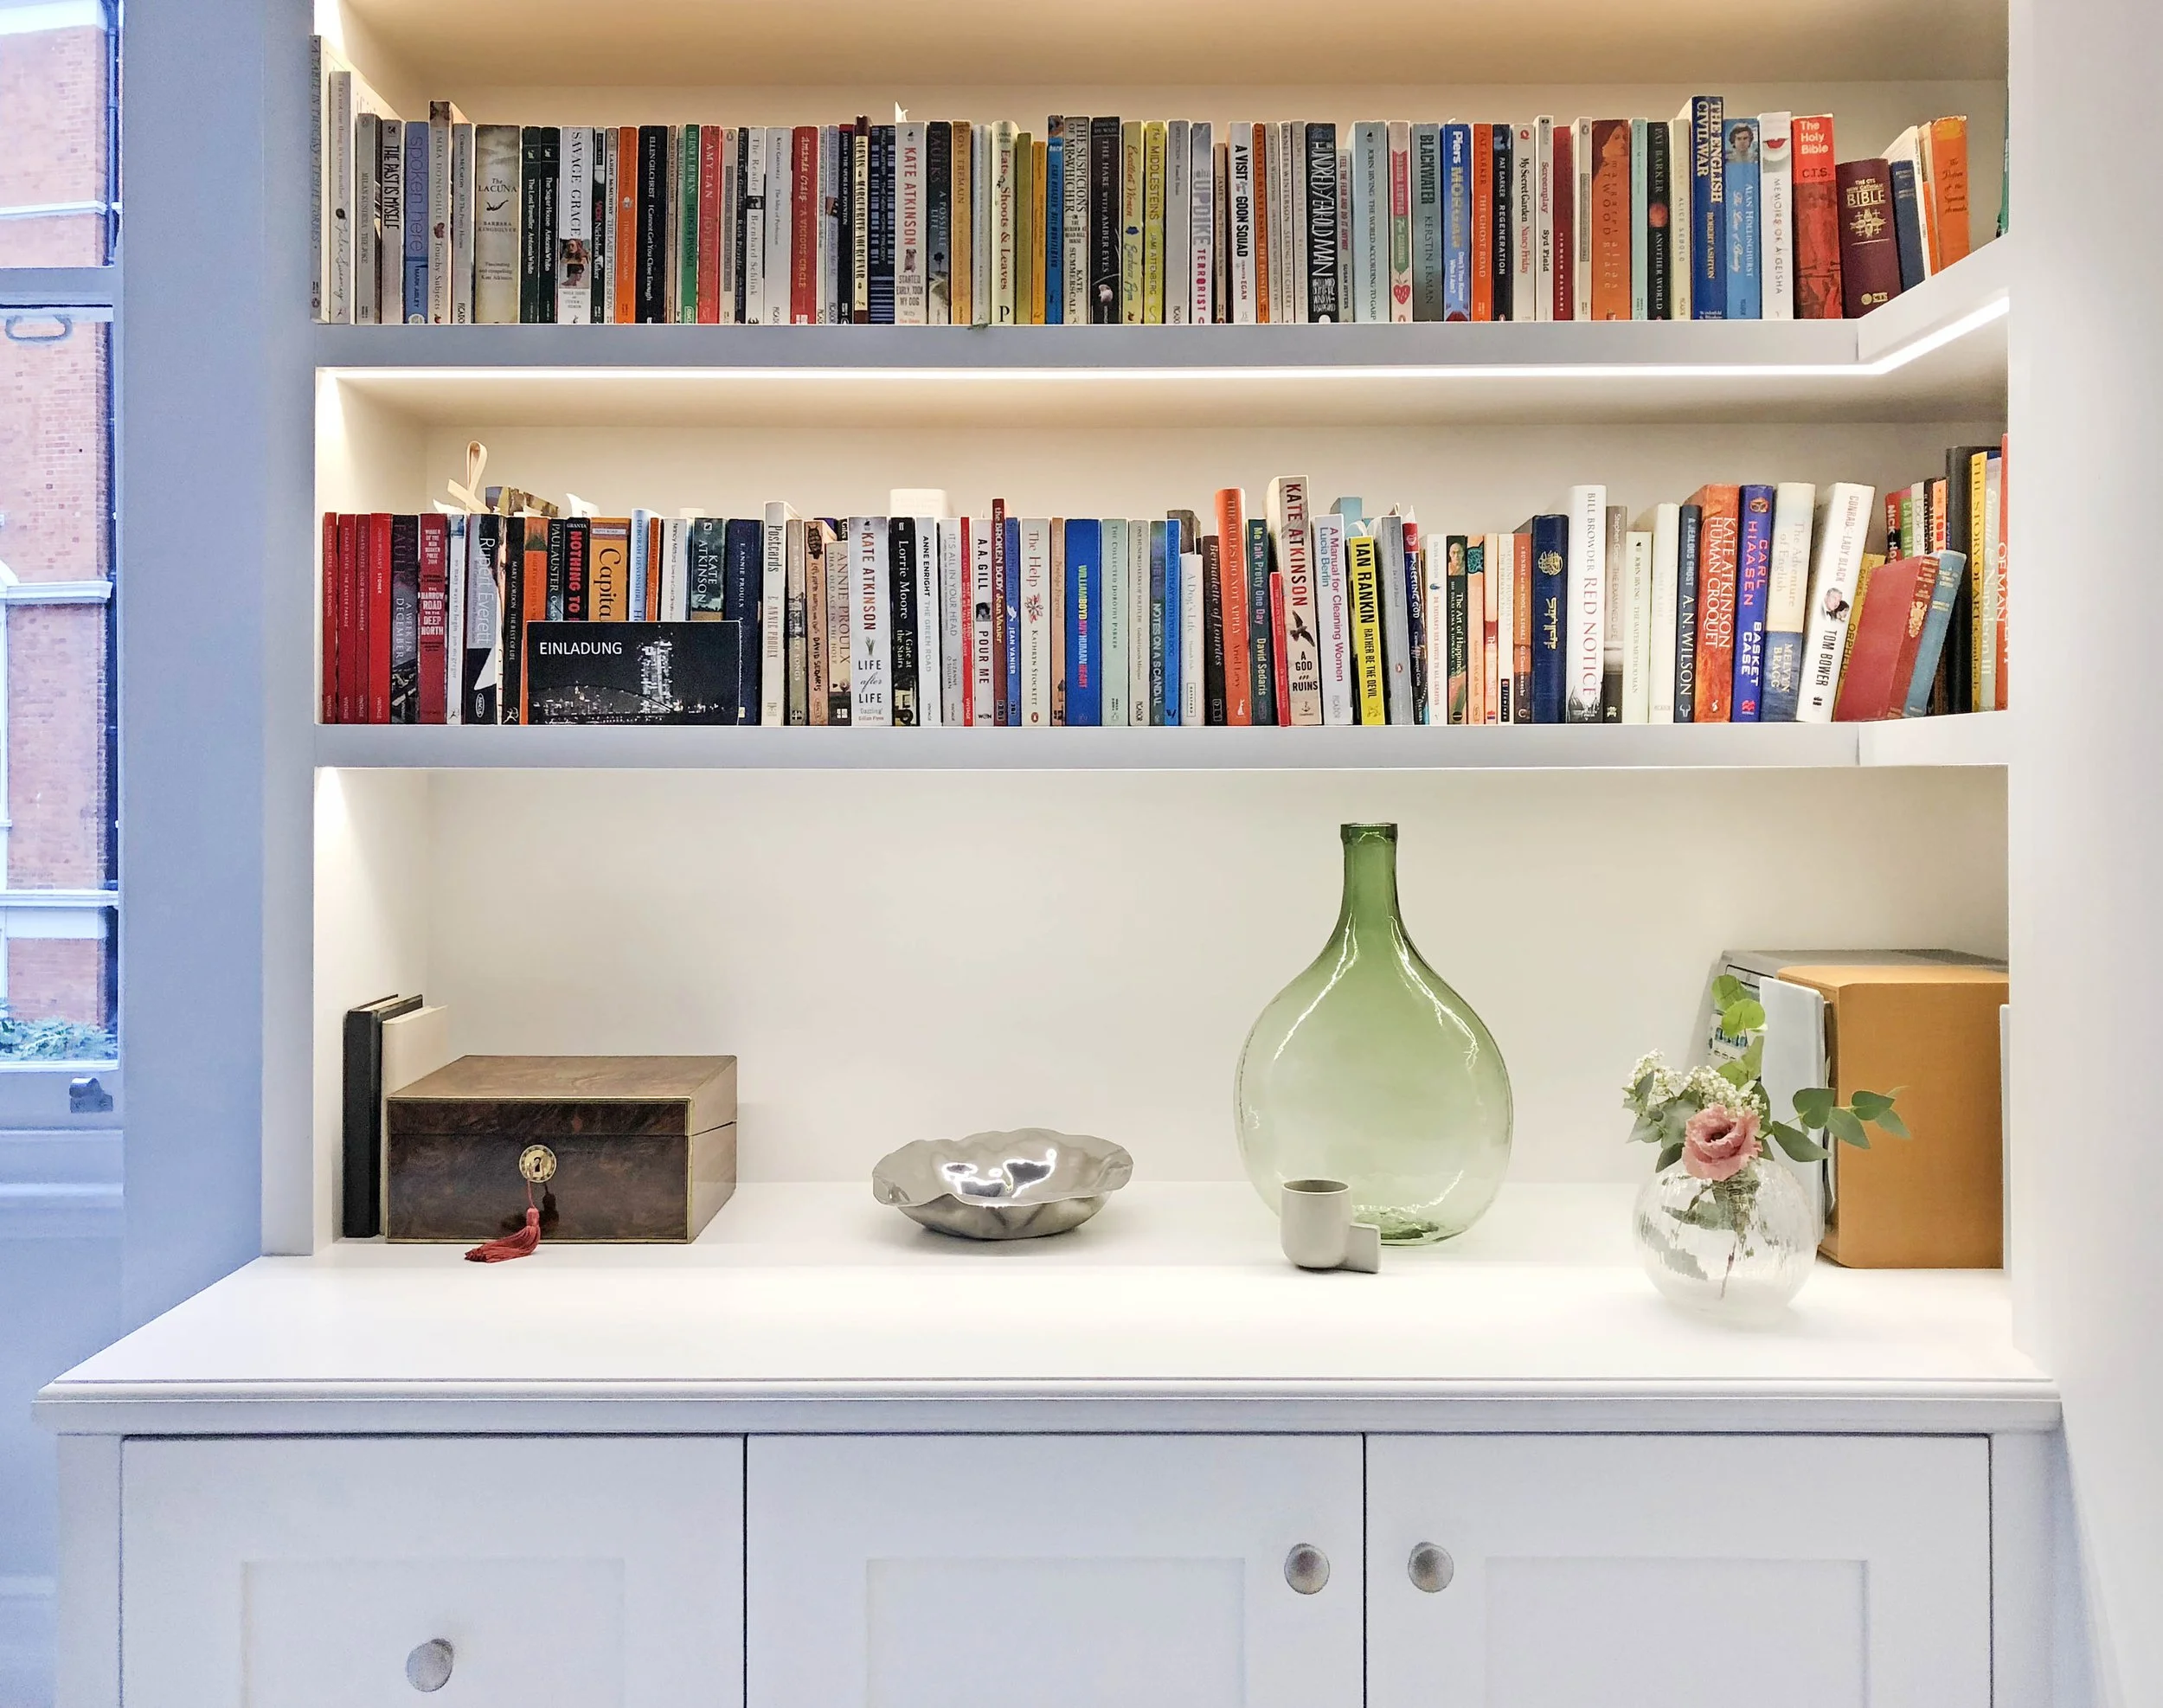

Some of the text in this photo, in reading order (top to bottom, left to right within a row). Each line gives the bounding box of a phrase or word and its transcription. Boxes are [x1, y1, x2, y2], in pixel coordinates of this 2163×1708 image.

[1069, 124, 1075, 135] OF
[1697, 101, 1708, 177] CIVIL WAR
[1801, 121, 1820, 130] The
[1801, 132, 1823, 142] Holy
[384, 146, 399, 162] THE
[1076, 122, 1086, 212] THE SUSPICIONS
[1236, 155, 1248, 180] VISIT
[1420, 135, 1435, 204] BLACKWATER
[1520, 157, 1530, 169] My
[1710, 102, 1722, 202] THE ENGLISH
[1801, 144, 1827, 154] Bible
[384, 164, 399, 185] PAST
[408, 137, 427, 251] spoken here
[571, 132, 582, 237] SAVAGE GRACE
[383, 197, 398, 229] MYSELF
[904, 147, 916, 245] KATE ATKINSON
[1236, 196, 1248, 222] GOON
[1847, 192, 1884, 206] BIBLE
[1000, 187, 1010, 290] Shoots & Leaves
[1236, 225, 1248, 257] SQUAD
[1312, 238, 1334, 276] MAN
[1424, 216, 1433, 261] KERSTIN
[1519, 226, 1529, 249] Nancy
[433, 242, 442, 310] Touchy Subjects
[1197, 249, 1206, 311] TERRORIST
[1520, 251, 1530, 274] Friday
[1973, 461, 1981, 496] THE
[1587, 492, 1595, 571] BILL BROWDER
[1888, 505, 1897, 534] NICK
[1972, 501, 1980, 557] STORY
[1028, 530, 1040, 551] The
[1287, 483, 1308, 607] KATE ATKINSON
[1320, 527, 1331, 588] Lucia Berlin
[1356, 543, 1370, 567] IAN
[569, 531, 582, 613] NOTHING TO
[696, 540, 708, 604] ATKINSON
[708, 555, 717, 585] KATE
[862, 532, 876, 630] KATE ATKINSON
[898, 541, 910, 620] Lorrie Moore
[948, 568, 956, 578] IN
[1027, 556, 1040, 588] Help
[1704, 517, 1723, 649] HUMAN CROQUET
[1718, 517, 1736, 649] KATE ATKINSON
[1744, 521, 1758, 606] HIAASEN
[1757, 540, 1768, 588] CARL
[1775, 533, 1788, 592] of English
[1788, 522, 1805, 607] The Adventure
[1972, 562, 1980, 584] OF
[477, 538, 495, 645] Rupert Everett
[948, 581, 957, 608] YOUR
[977, 539, 989, 684] A.A. GILL POUR ME
[1254, 527, 1267, 696] Me Talk Pretty One Day David Sedaris
[1330, 527, 1344, 682] A Manual for Cleaning Women
[1358, 573, 1375, 624] RANKIN
[1815, 496, 1859, 686] CONRAD LADY BLACK TOM BOWER
[395, 598, 404, 658] DECEMBER
[949, 611, 958, 636] HEAD
[1364, 629, 1373, 654] RATHER
[1582, 578, 1597, 696] RED NOTICE
[540, 642, 622, 655] EINLADUNG
[858, 659, 881, 670] LIFE
[896, 645, 905, 668] Stairs
[1295, 661, 1312, 671] GOD
[1301, 651, 1306, 660] A
[1741, 632, 1752, 675] CASE
[1752, 622, 1762, 686] BASKET
[1770, 647, 1782, 688] BRAGG
[1293, 682, 1319, 692] RUINS
[1366, 666, 1375, 678] THE
[1367, 680, 1377, 698] DEVIL
[858, 692, 883, 703] LIFE
